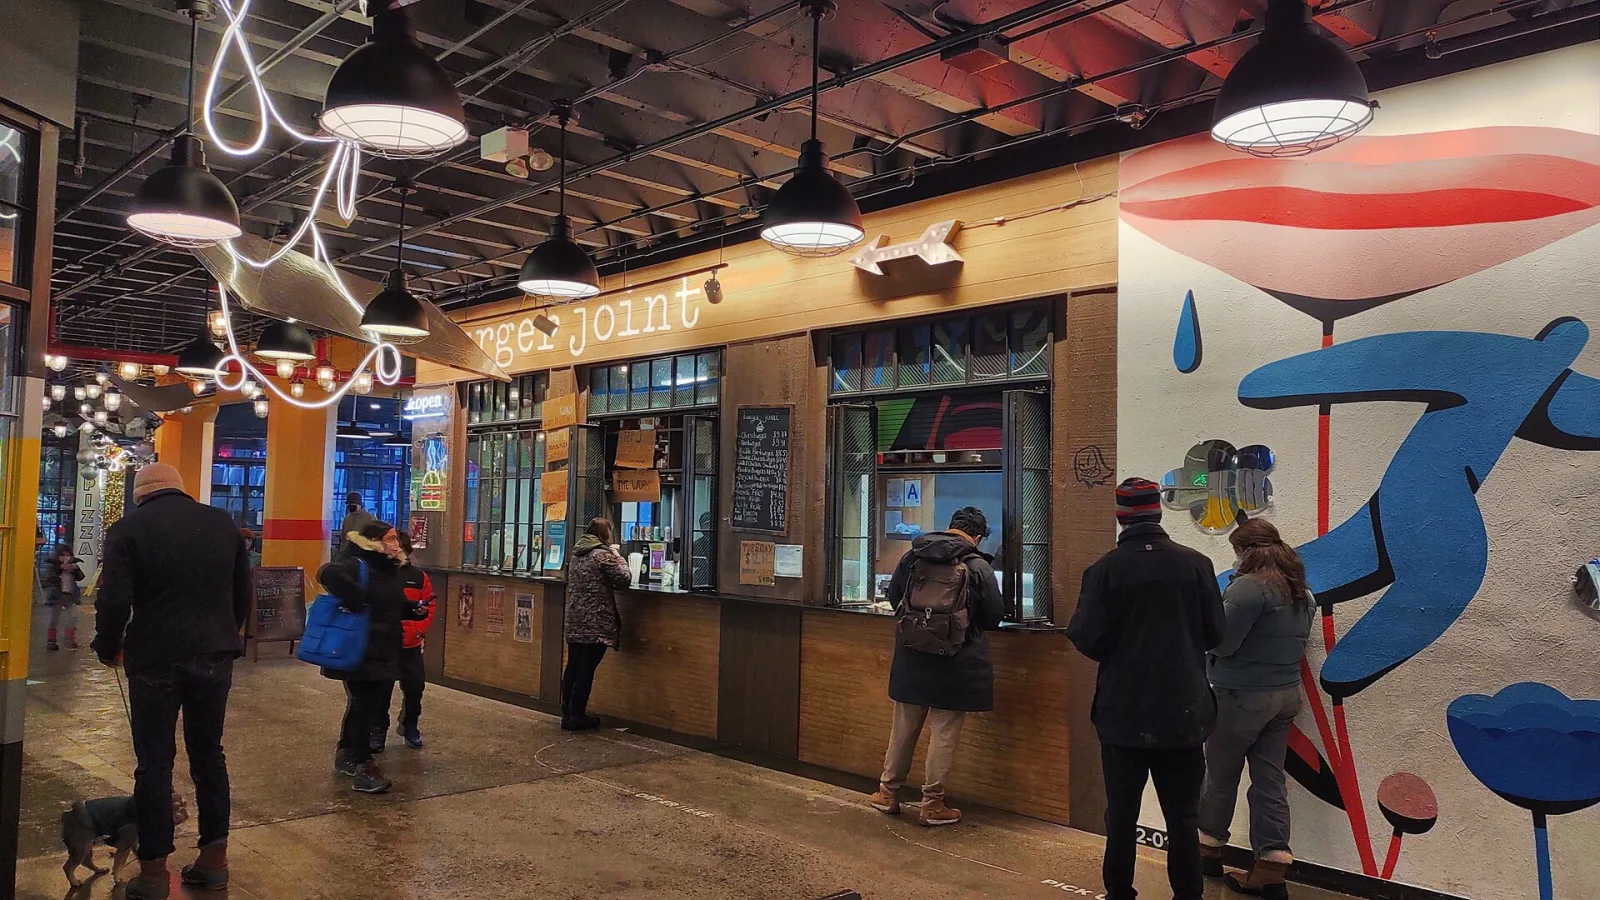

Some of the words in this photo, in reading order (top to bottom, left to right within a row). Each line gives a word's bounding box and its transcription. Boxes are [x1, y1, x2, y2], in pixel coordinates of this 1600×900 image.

[569, 276, 701, 357] joint
[415, 394, 443, 413] open
[617, 480, 630, 491] THE
[907, 483, 918, 500] A
[78, 478, 96, 555] PIZZA
[742, 542, 774, 553] TUESDAY
[1040, 879, 1094, 896] PICK
